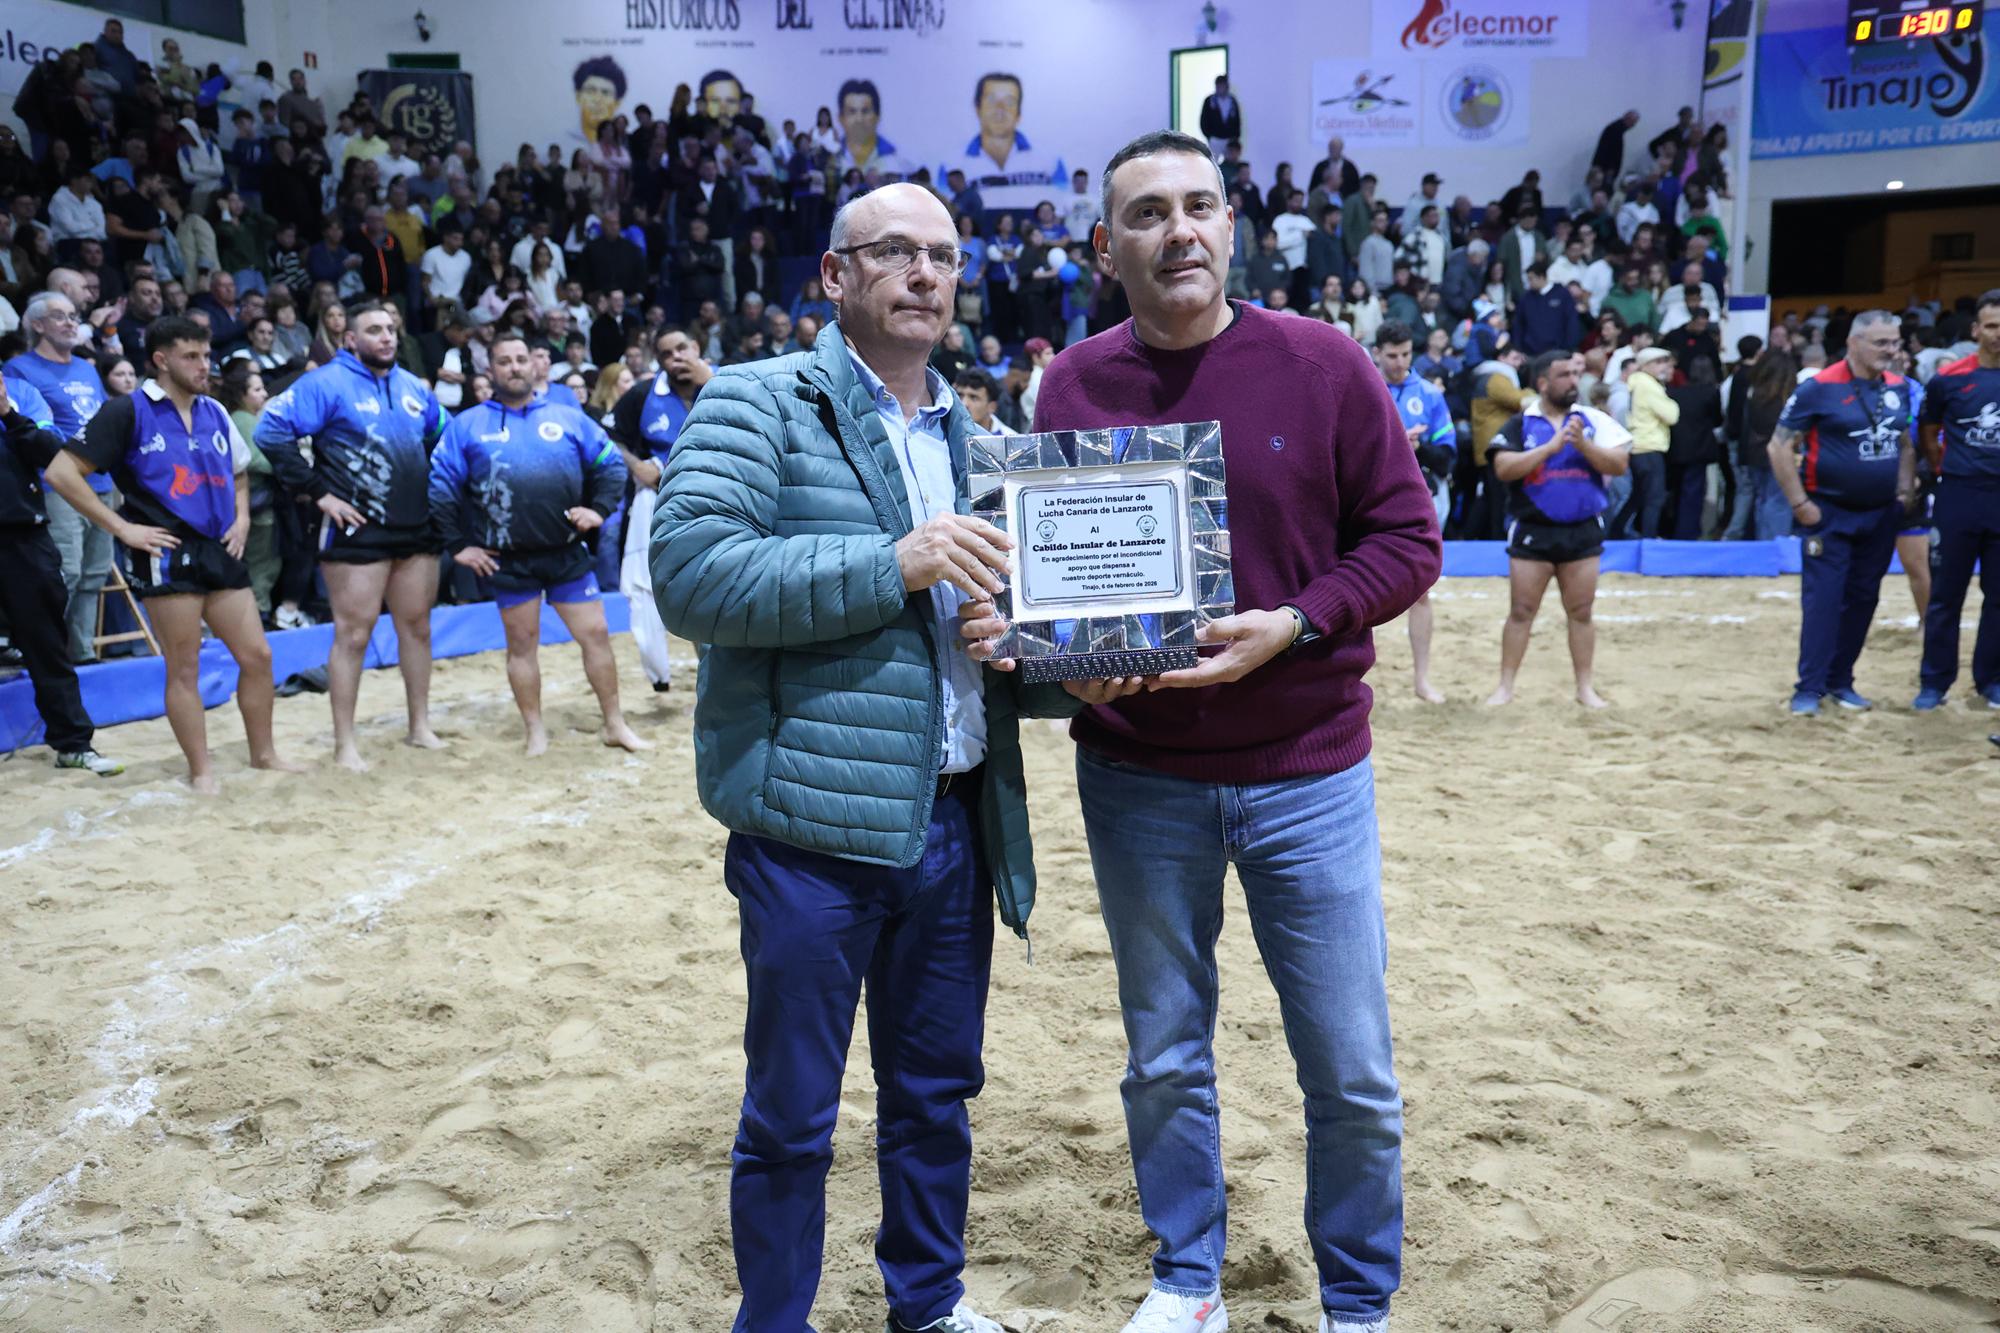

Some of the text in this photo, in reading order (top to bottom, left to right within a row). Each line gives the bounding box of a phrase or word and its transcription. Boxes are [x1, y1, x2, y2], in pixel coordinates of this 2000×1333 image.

[1900, 9, 1951, 38] 1:30
[1955, 8, 1973, 29] 0
[1855, 20, 1872, 41] 0
[1044, 493, 1146, 507] La Federación Insular de
[1038, 504, 1153, 518] Lucha Canaria de Lanzarote
[1090, 526, 1100, 534] Al
[1032, 543, 1068, 552] Cabildo
[1070, 541, 1104, 550] Insular
[1119, 538, 1166, 547] Lanzarote
[1051, 553, 1100, 563] agradecimiento
[1120, 549, 1162, 558] incondicional
[1102, 562, 1130, 570] dispensa
[1087, 573, 1112, 581] deporte
